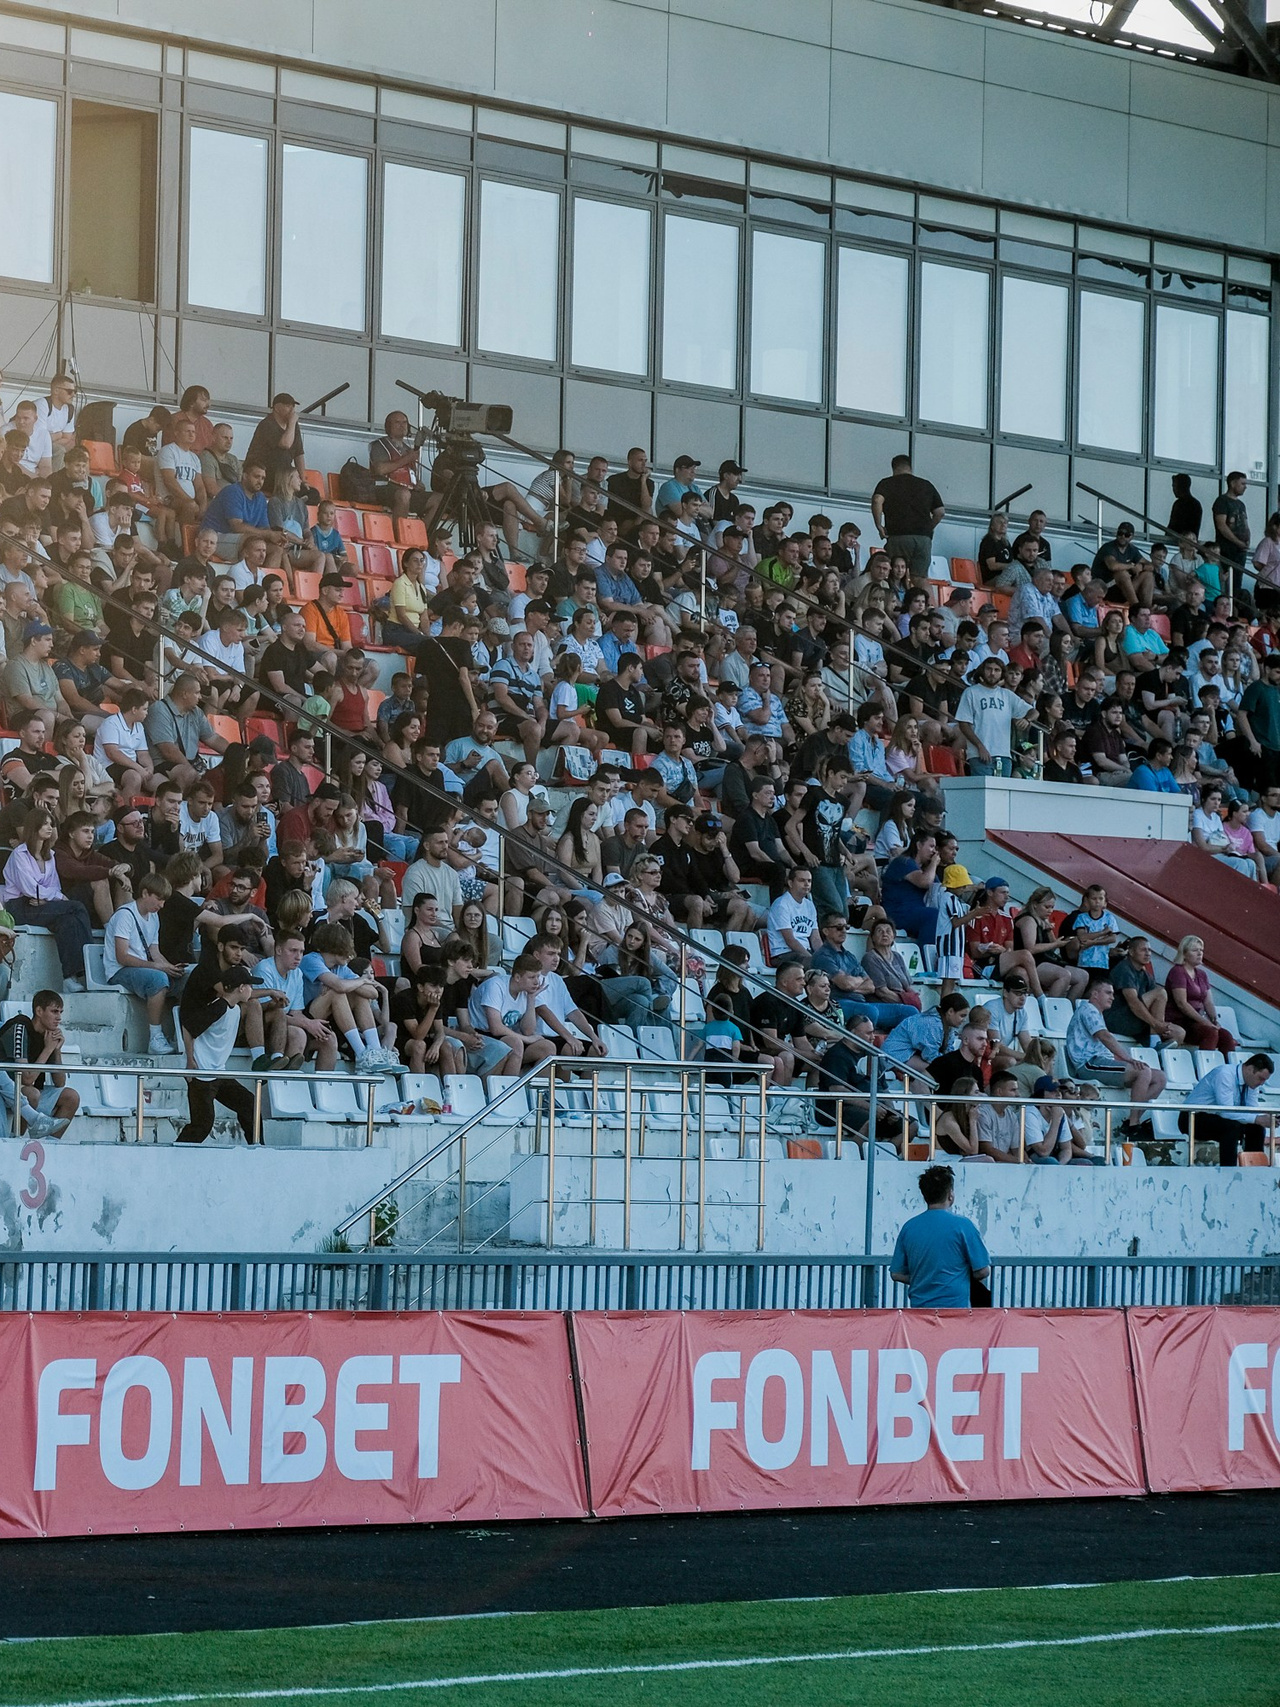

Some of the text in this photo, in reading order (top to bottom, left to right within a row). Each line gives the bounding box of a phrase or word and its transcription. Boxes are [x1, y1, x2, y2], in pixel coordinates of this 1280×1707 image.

[980, 697, 1005, 711] GAP
[19, 1141, 47, 1210] 3
[33, 1354, 462, 1492] FONBET
[691, 1346, 1039, 1471] FONBET
[1228, 1343, 1280, 1452] F
